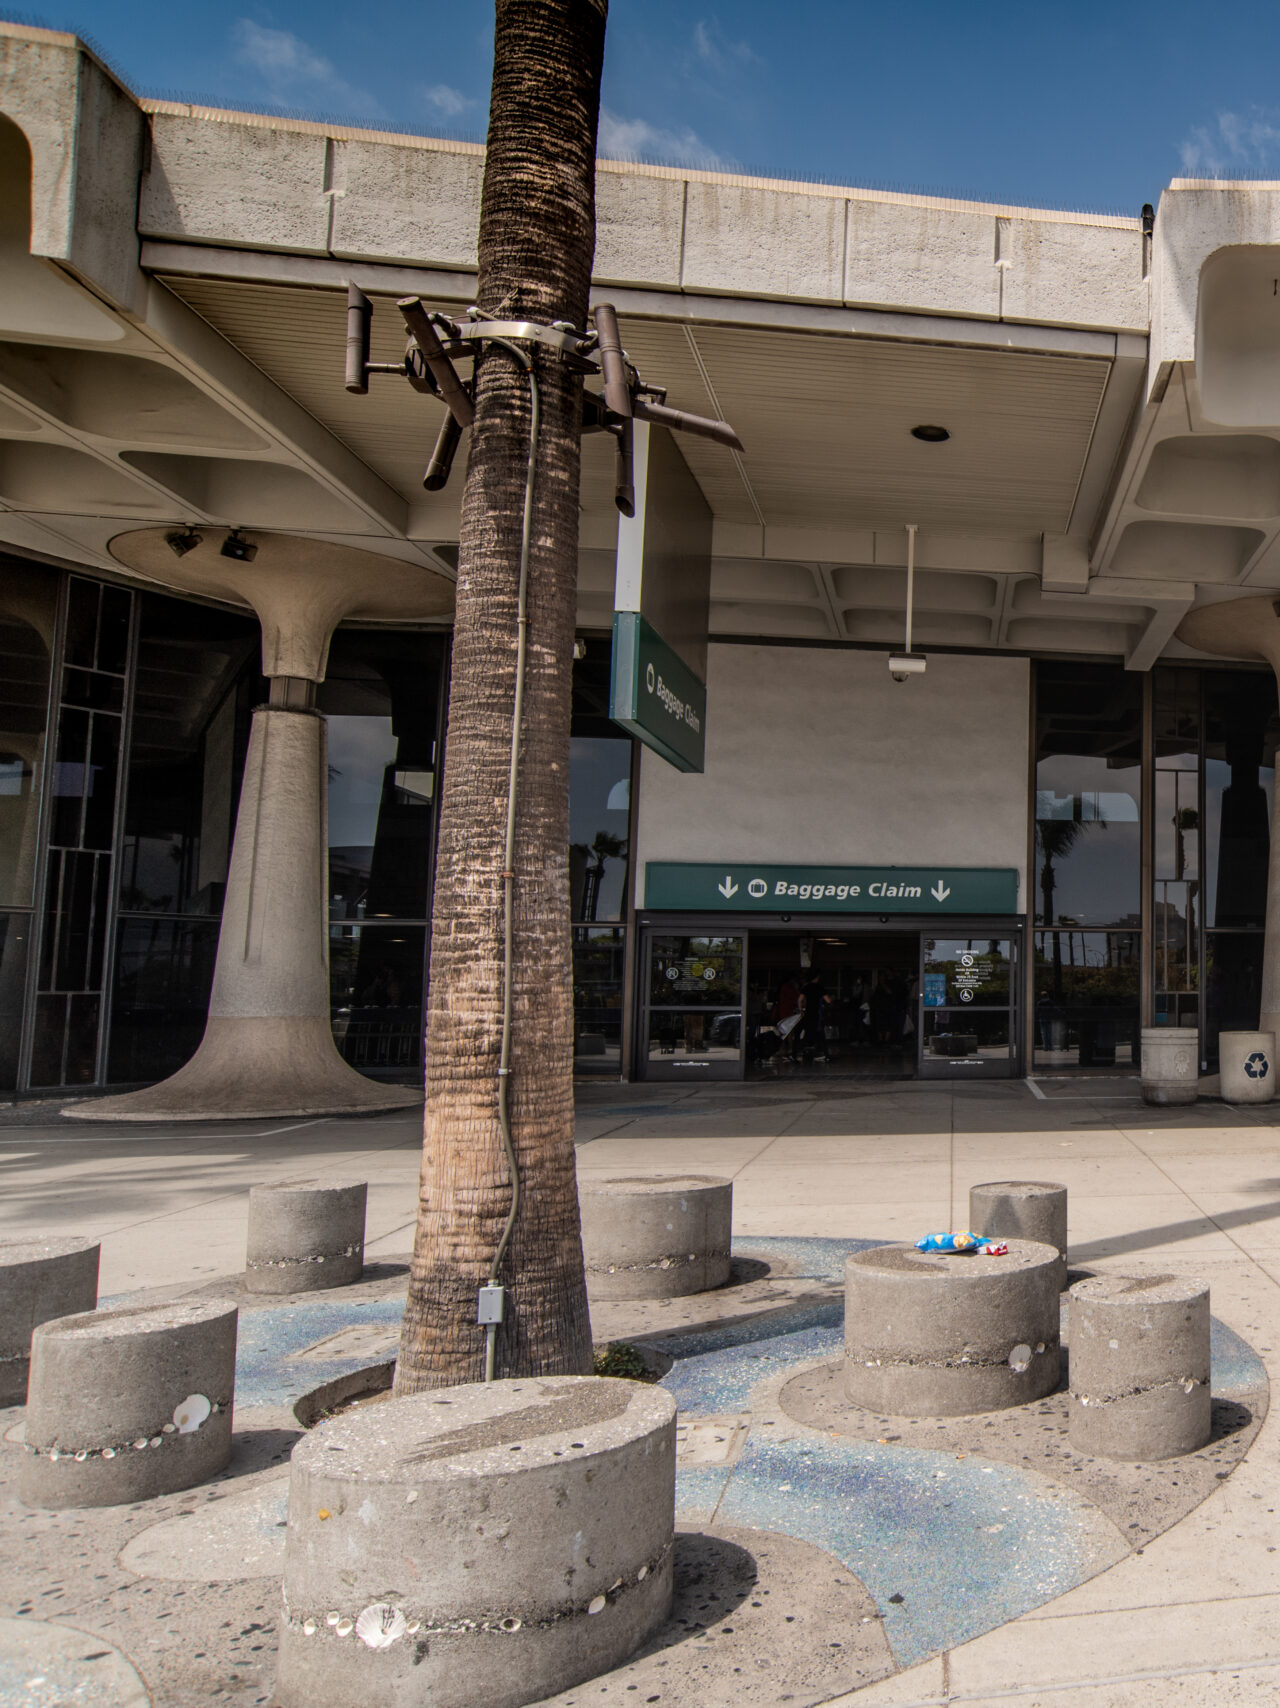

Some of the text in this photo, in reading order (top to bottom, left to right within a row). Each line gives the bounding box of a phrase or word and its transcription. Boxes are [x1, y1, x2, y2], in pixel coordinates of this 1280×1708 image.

[657, 675, 700, 734] Baggage Claim
[774, 881, 922, 900] Baggage Claim
